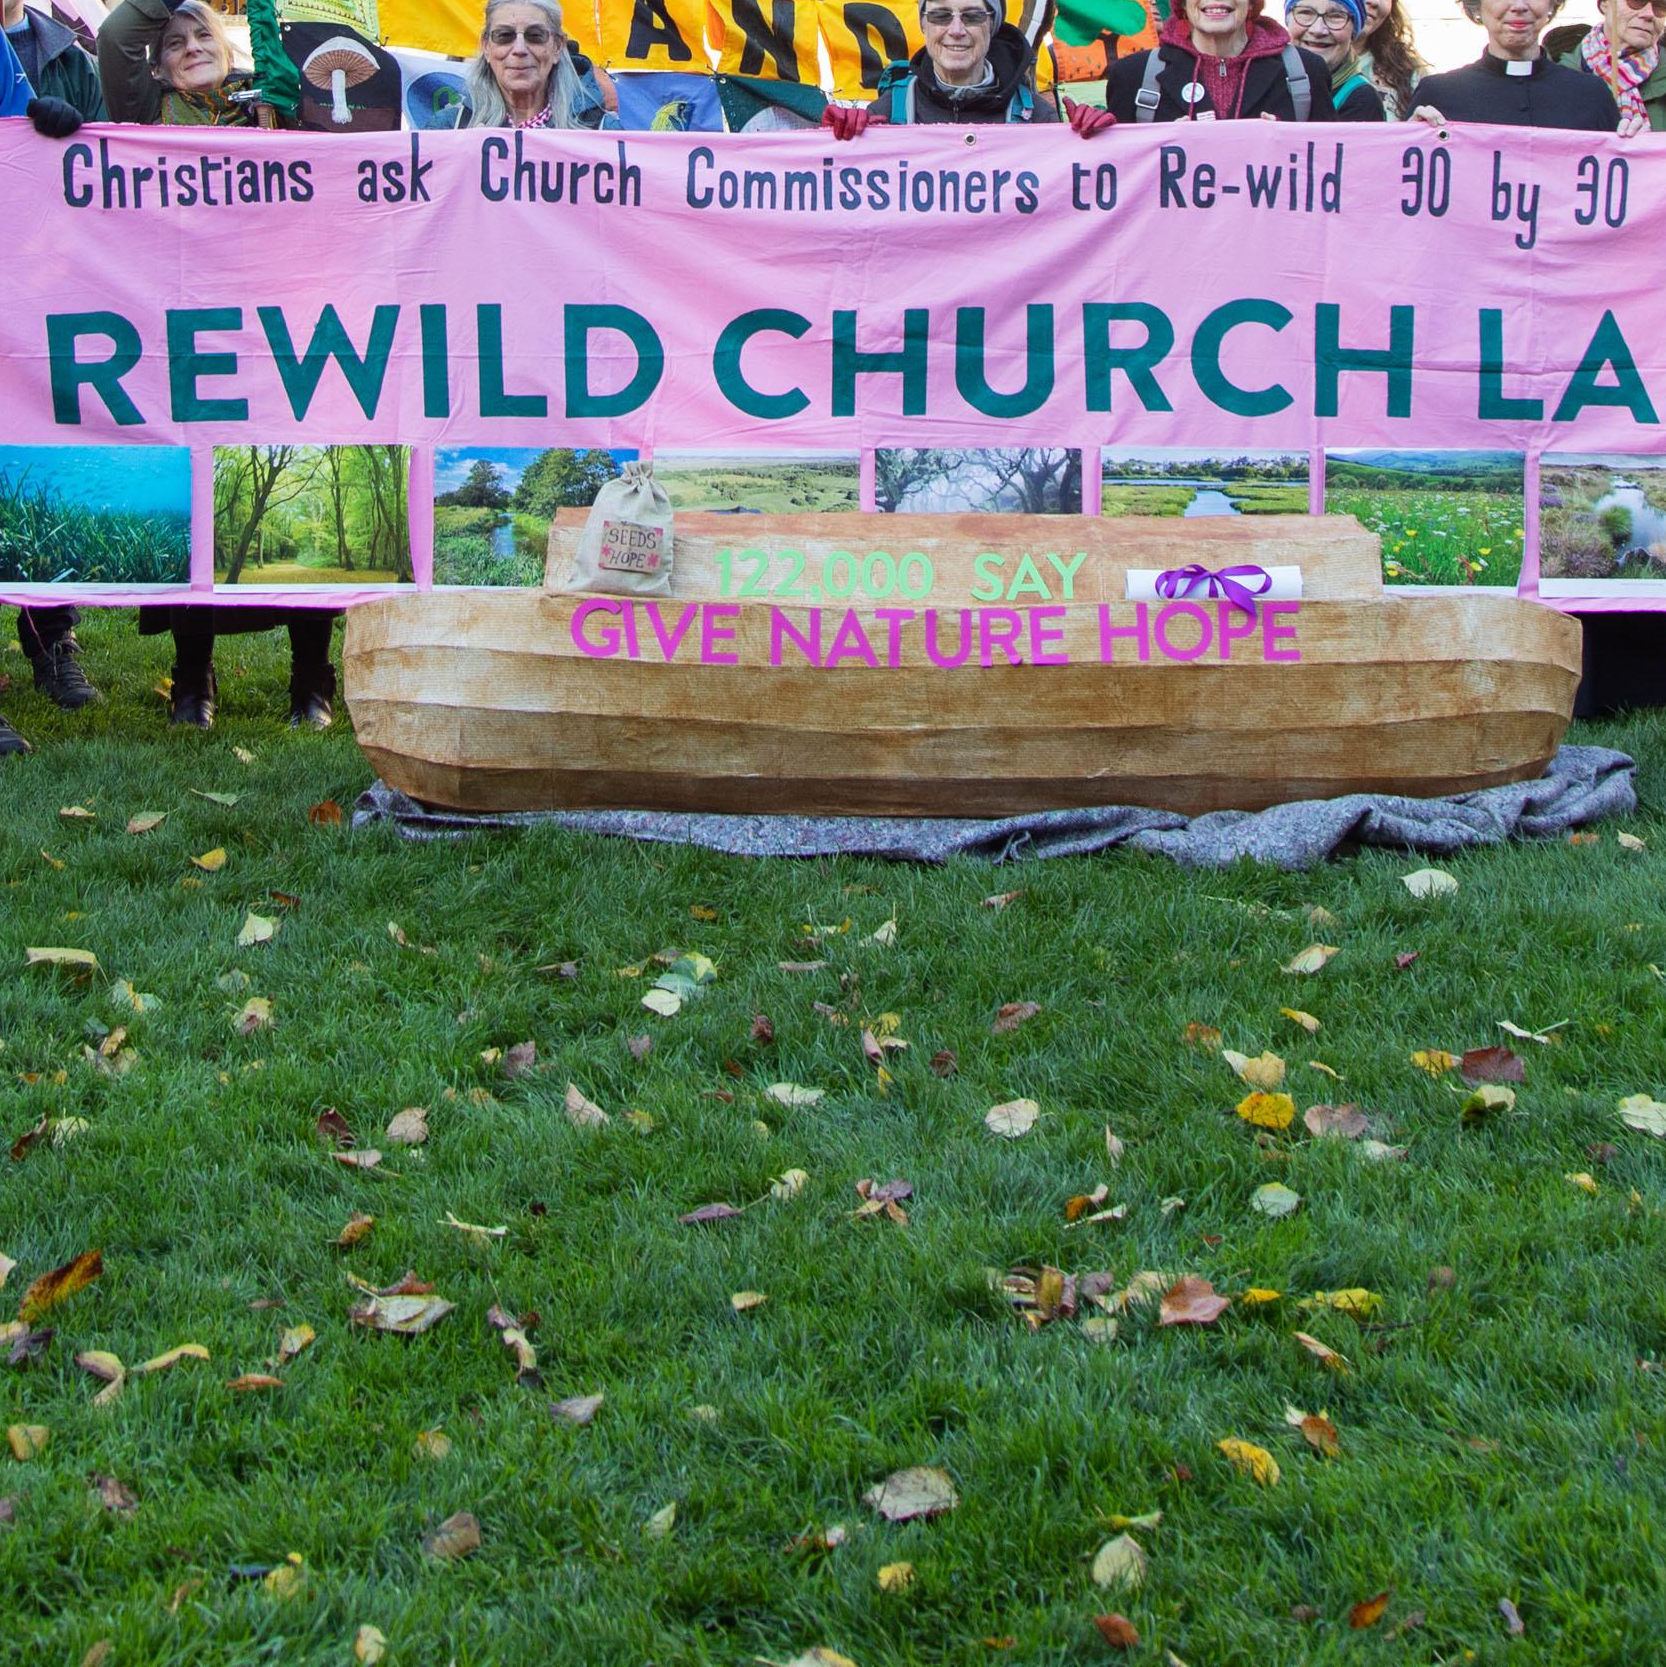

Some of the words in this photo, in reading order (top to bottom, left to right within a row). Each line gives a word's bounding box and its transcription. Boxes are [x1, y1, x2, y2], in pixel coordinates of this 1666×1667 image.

[62, 141, 314, 211] Christians
[356, 132, 433, 203] ask
[480, 131, 641, 207] Church
[685, 145, 1039, 214] Commissioners
[1072, 161, 1117, 211] to
[1159, 141, 1344, 214] Re-wild
[1402, 146, 1451, 218] 30
[1491, 150, 1540, 250] by
[1574, 155, 1629, 228] 30
[46, 303, 665, 426] REWILD
[714, 298, 1413, 419] CHURCH
[608, 527, 657, 550] SEEDS
[609, 549, 647, 569] HOPE
[714, 548, 934, 604] 122,000
[971, 551, 1087, 602] SAY
[571, 598, 740, 664] GIVE
[770, 605, 1070, 669] NATURE
[1099, 598, 1302, 664] HOPE
